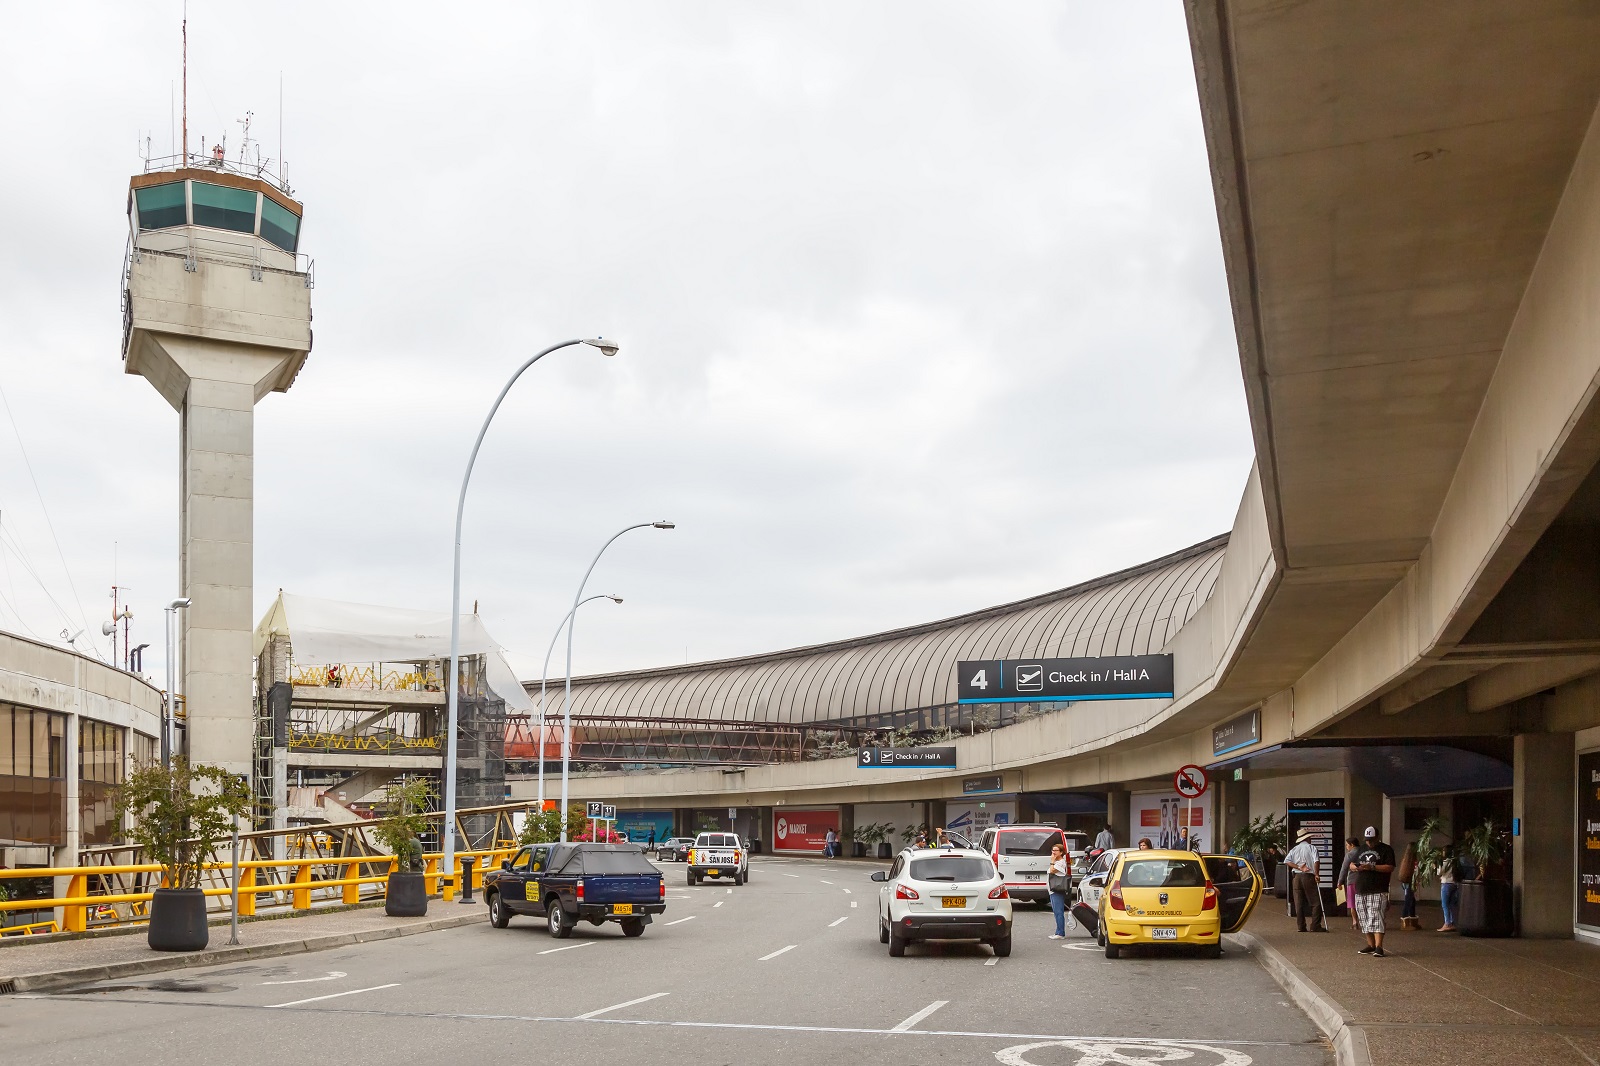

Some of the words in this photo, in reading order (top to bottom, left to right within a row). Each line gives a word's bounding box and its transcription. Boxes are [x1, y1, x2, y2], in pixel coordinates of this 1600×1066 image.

[970, 669, 988, 690] 4
[1049, 670, 1086, 683] Check
[1090, 671, 1101, 682] in
[1113, 669, 1137, 681] Hall
[1139, 668, 1149, 681] A
[1251, 712, 1256, 737] 4
[862, 750, 871, 763] 3
[996, 777, 1001, 789] 3
[789, 823, 807, 834] MARKET
[709, 856, 720, 864] SAN
[721, 856, 734, 864] JOSE
